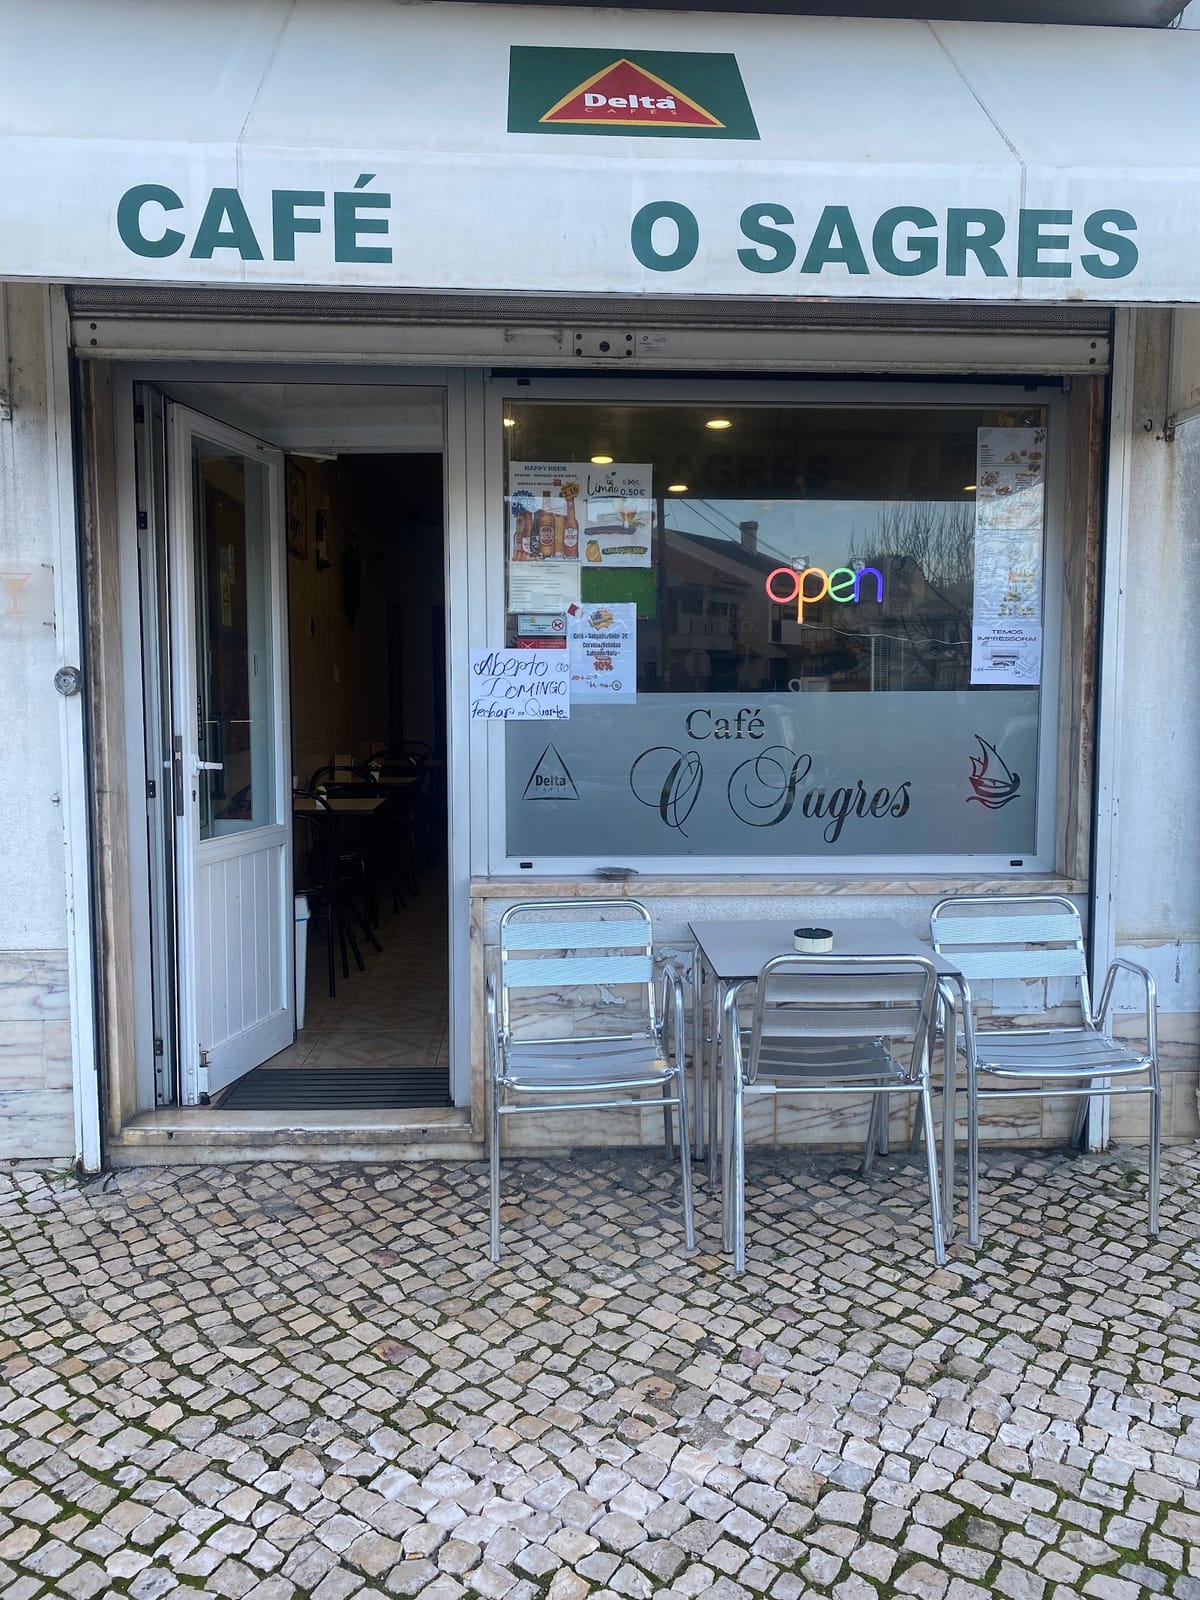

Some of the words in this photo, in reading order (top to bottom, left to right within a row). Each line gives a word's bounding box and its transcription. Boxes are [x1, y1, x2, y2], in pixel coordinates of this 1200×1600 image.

[584, 93, 677, 110] Delta
[118, 174, 392, 263] CAFÉ
[631, 201, 698, 271] O
[738, 204, 1138, 278] SAGRES
[765, 565, 884, 625] open
[473, 652, 549, 677] Aberto
[686, 708, 765, 740] Café
[535, 774, 566, 786] Delta
[630, 746, 704, 838] O
[727, 745, 912, 844] Sagres
